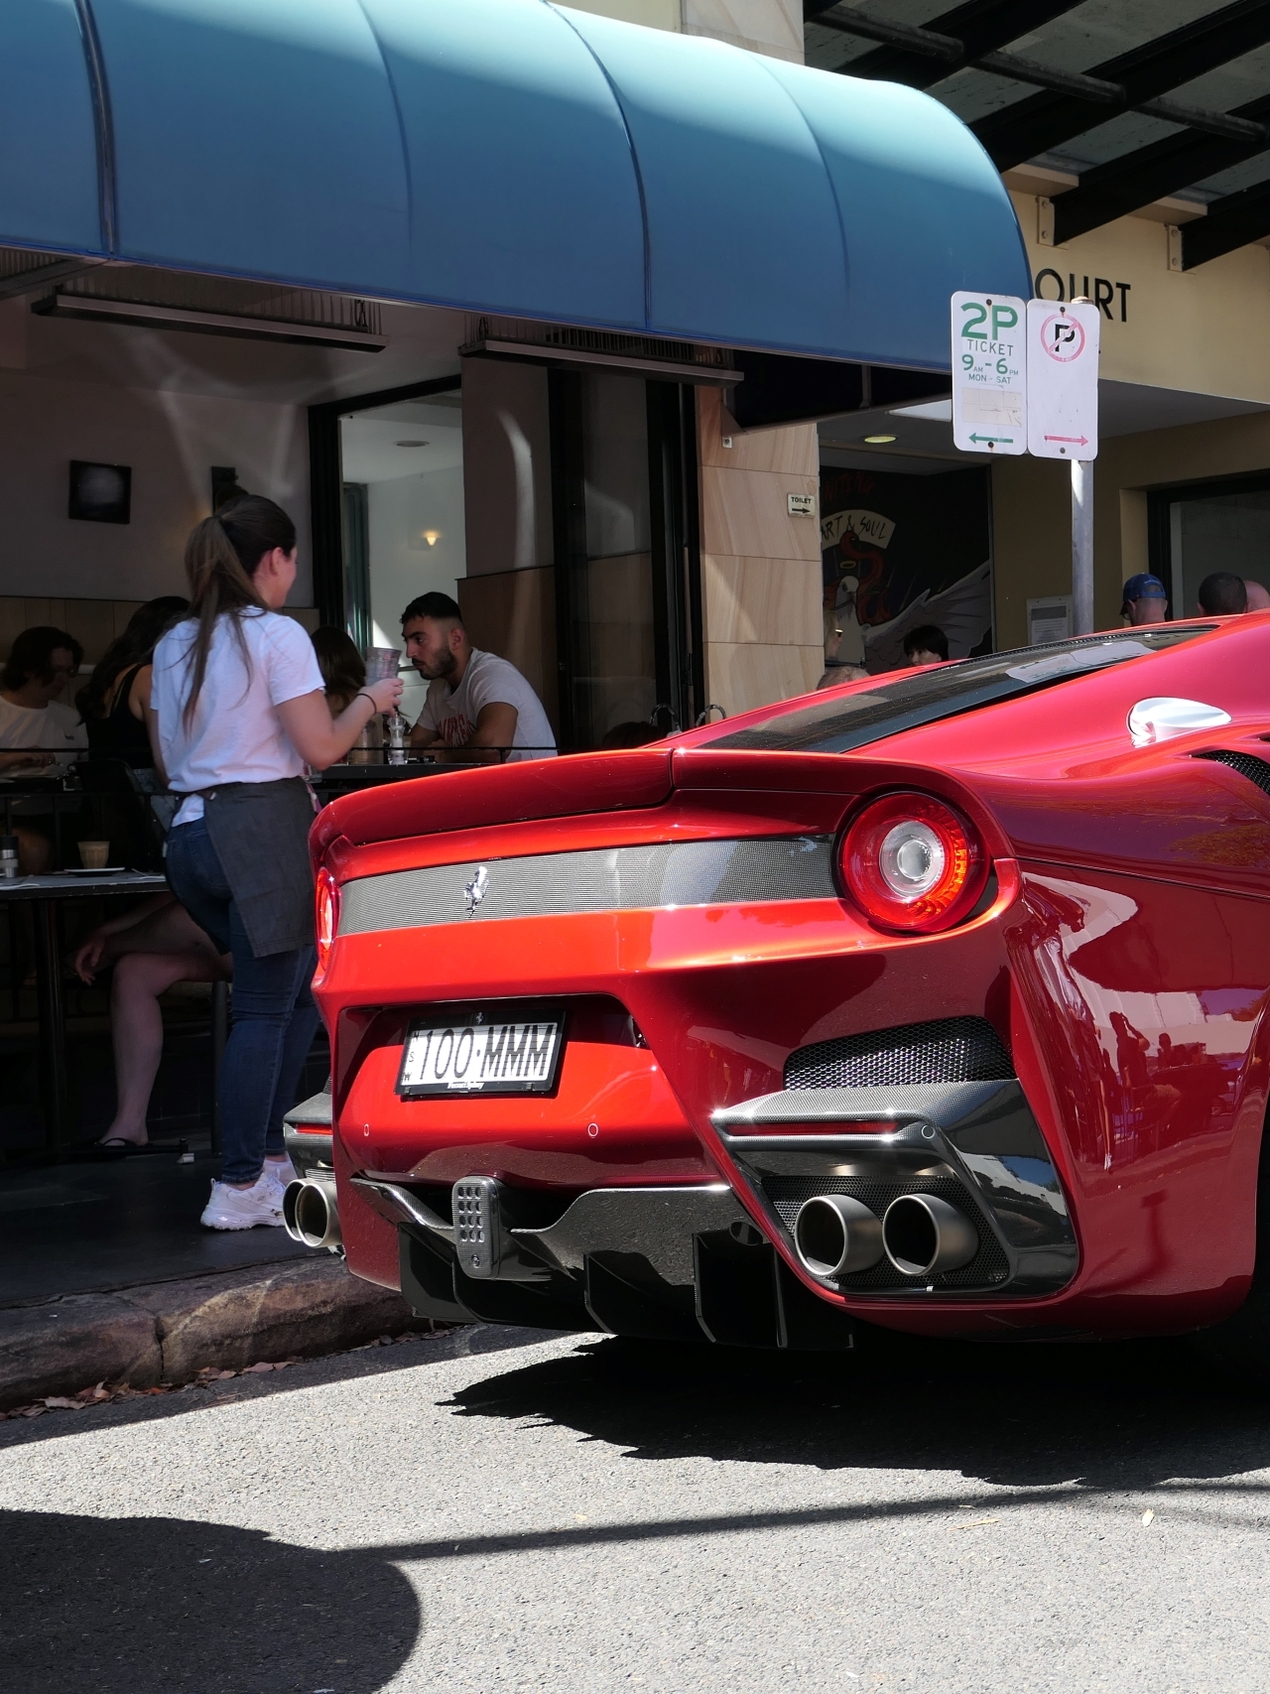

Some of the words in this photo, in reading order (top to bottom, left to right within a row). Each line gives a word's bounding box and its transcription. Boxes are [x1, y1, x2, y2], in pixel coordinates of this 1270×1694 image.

[961, 302, 1018, 341] 2P
[967, 339, 1014, 356] TICKET
[968, 373, 987, 382] MON
[996, 376, 1011, 384] SAT
[791, 496, 811, 504] TOILET
[858, 516, 886, 540] SOUL
